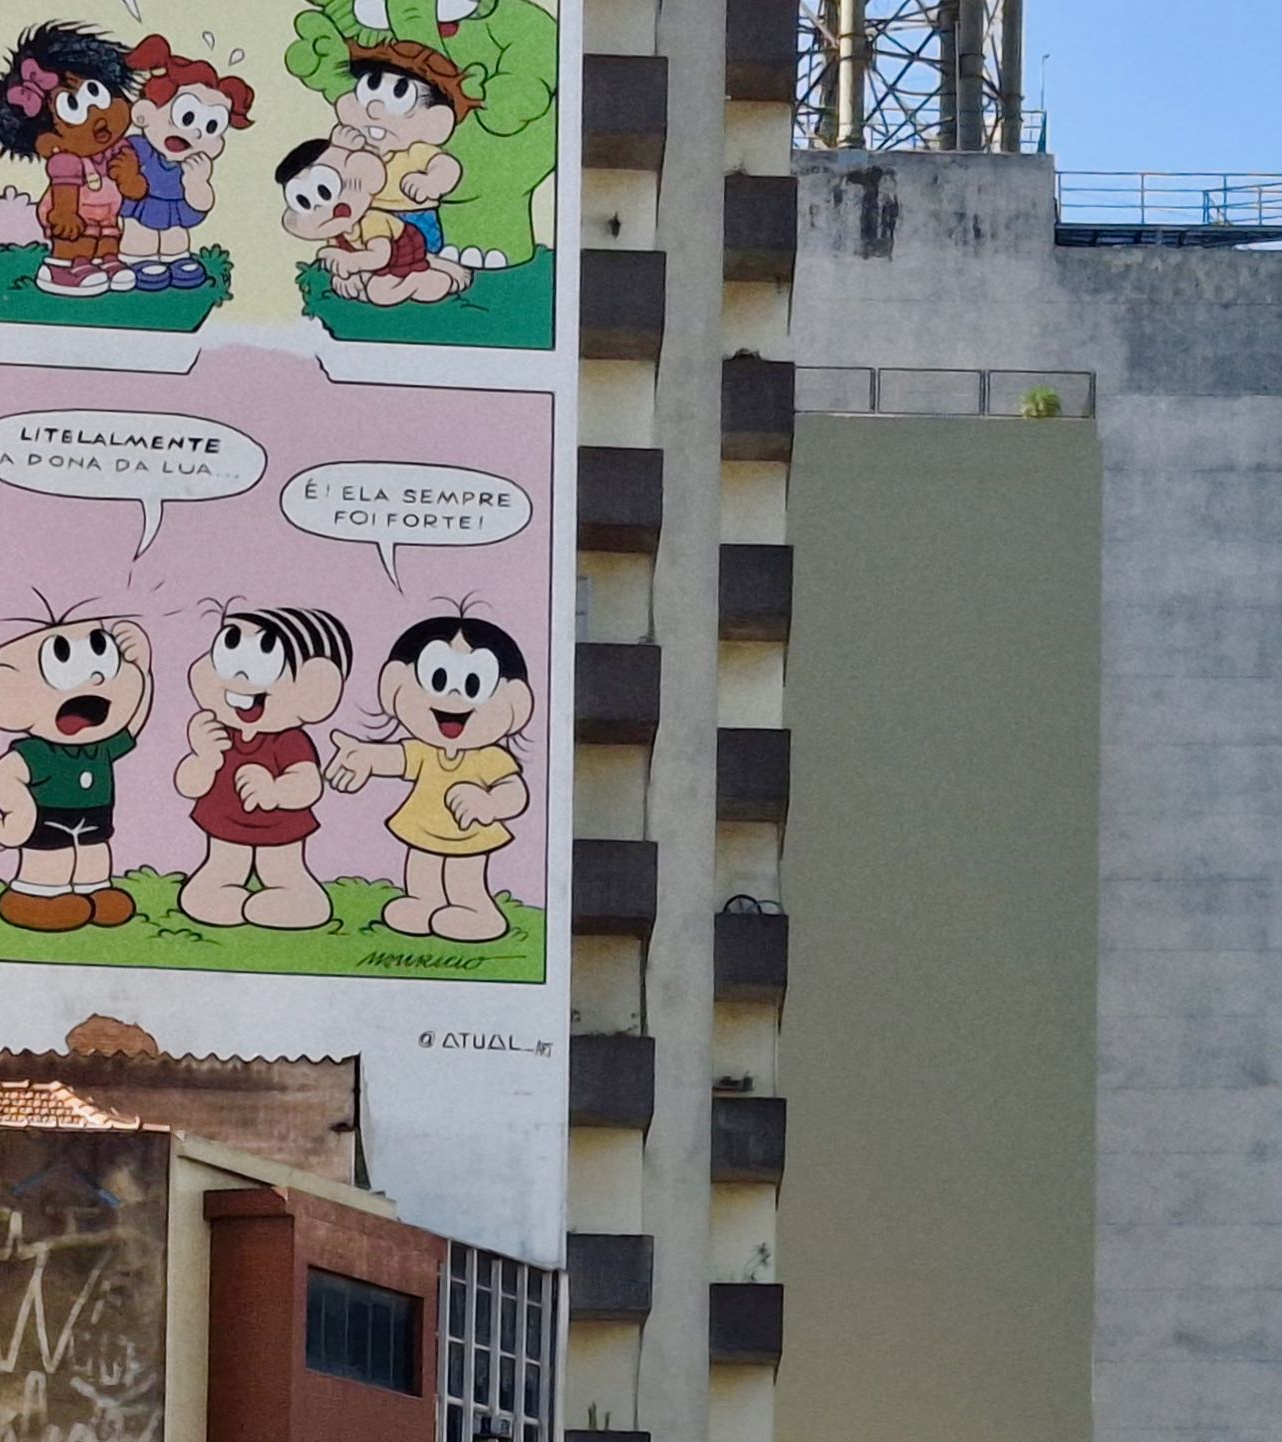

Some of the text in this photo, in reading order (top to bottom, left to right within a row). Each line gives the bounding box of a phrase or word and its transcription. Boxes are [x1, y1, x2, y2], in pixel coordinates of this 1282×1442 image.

[20, 427, 221, 454] LITELALMENTE
[0, 453, 15, 465] A
[28, 453, 102, 471] DONA
[115, 458, 149, 473] DA
[342, 485, 390, 501] ELA
[402, 488, 512, 508] SEMPRE
[334, 511, 484, 530] FOI FORTE!
